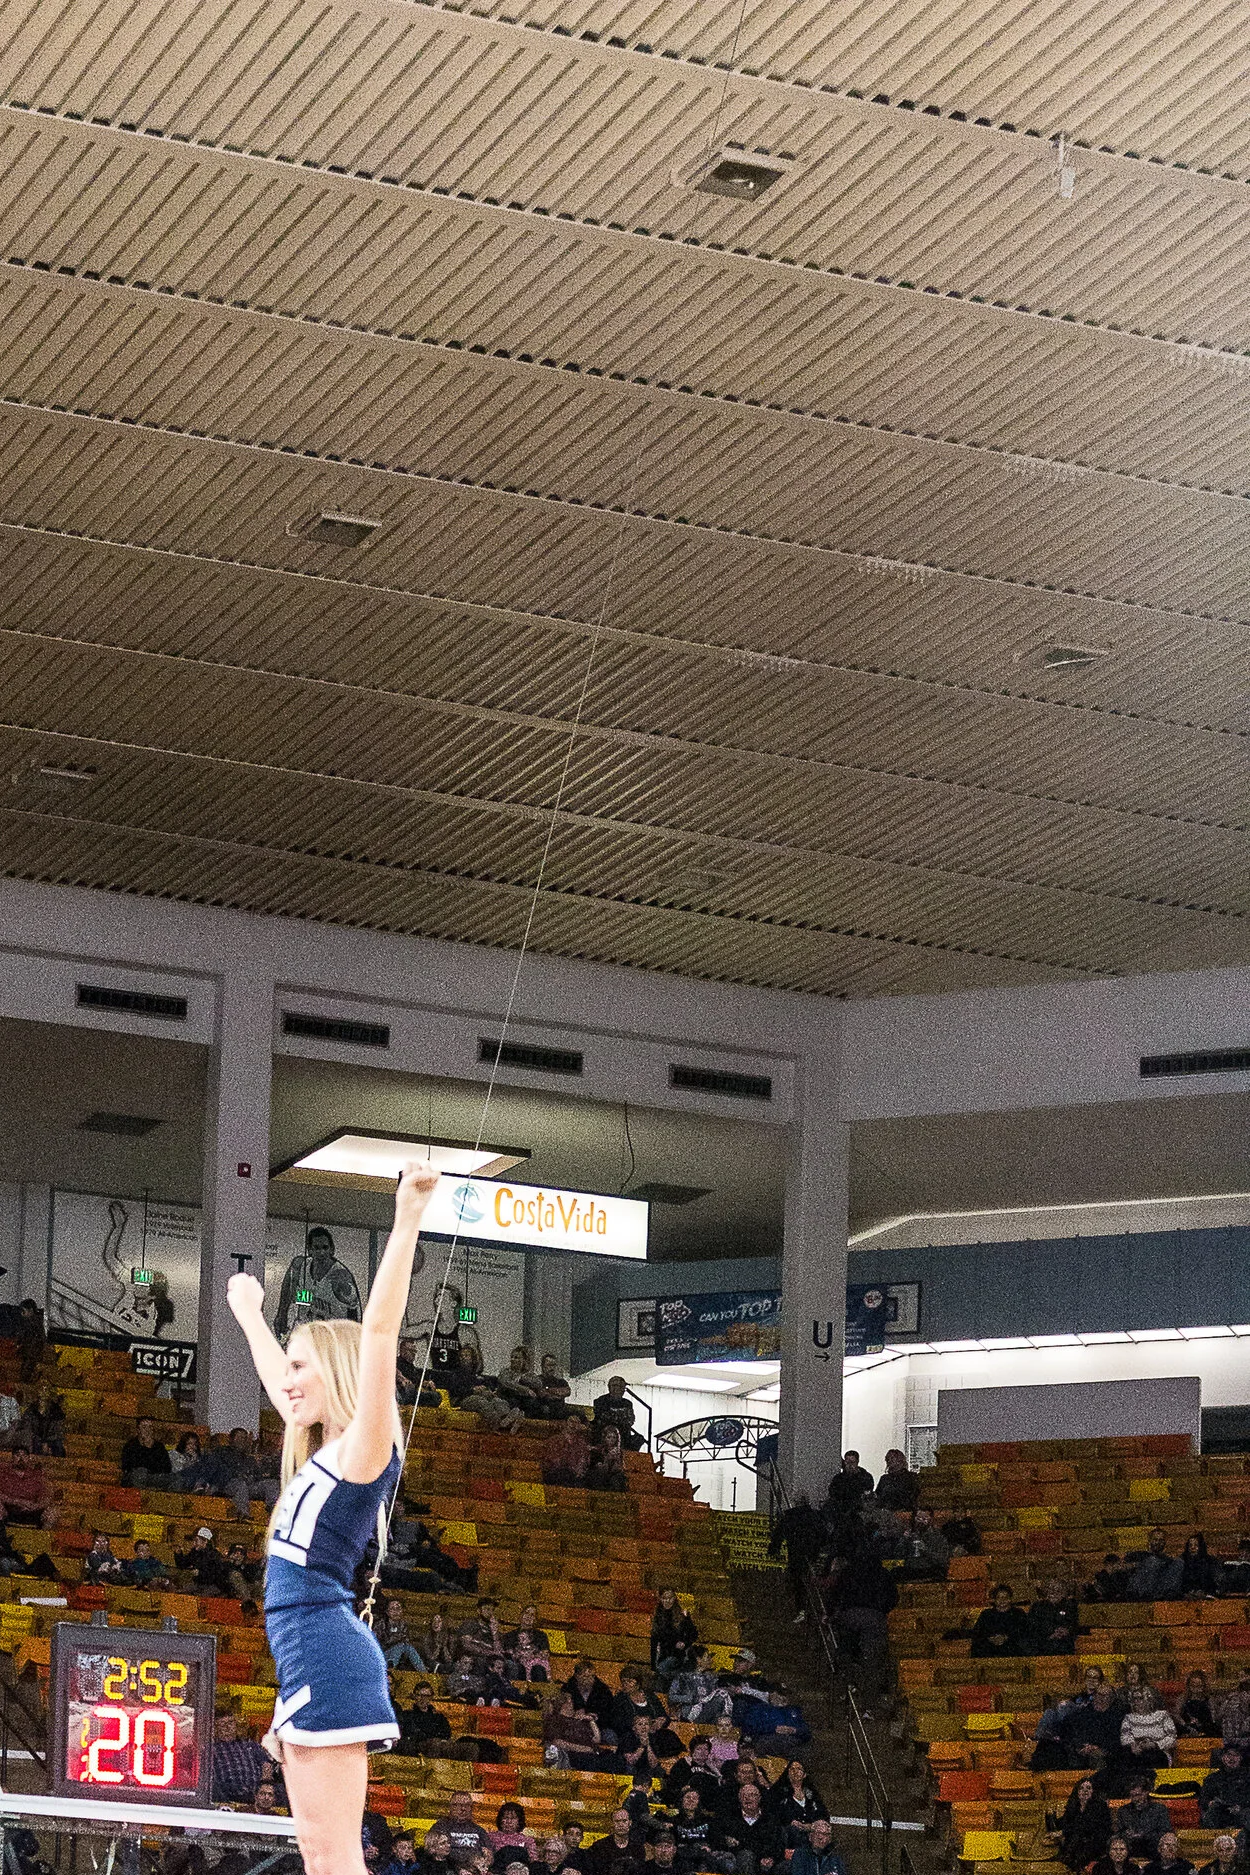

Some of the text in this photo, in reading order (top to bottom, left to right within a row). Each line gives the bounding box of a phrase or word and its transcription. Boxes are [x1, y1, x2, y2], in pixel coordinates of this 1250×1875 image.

[134, 1269, 153, 1283] EXIT
[296, 1289, 313, 1303] EXIT
[459, 1308, 476, 1322] EXIT
[813, 1320, 833, 1349] U
[439, 1348, 448, 1363] 3
[104, 1656, 188, 1705] 2:52
[88, 1705, 176, 1787] 20
